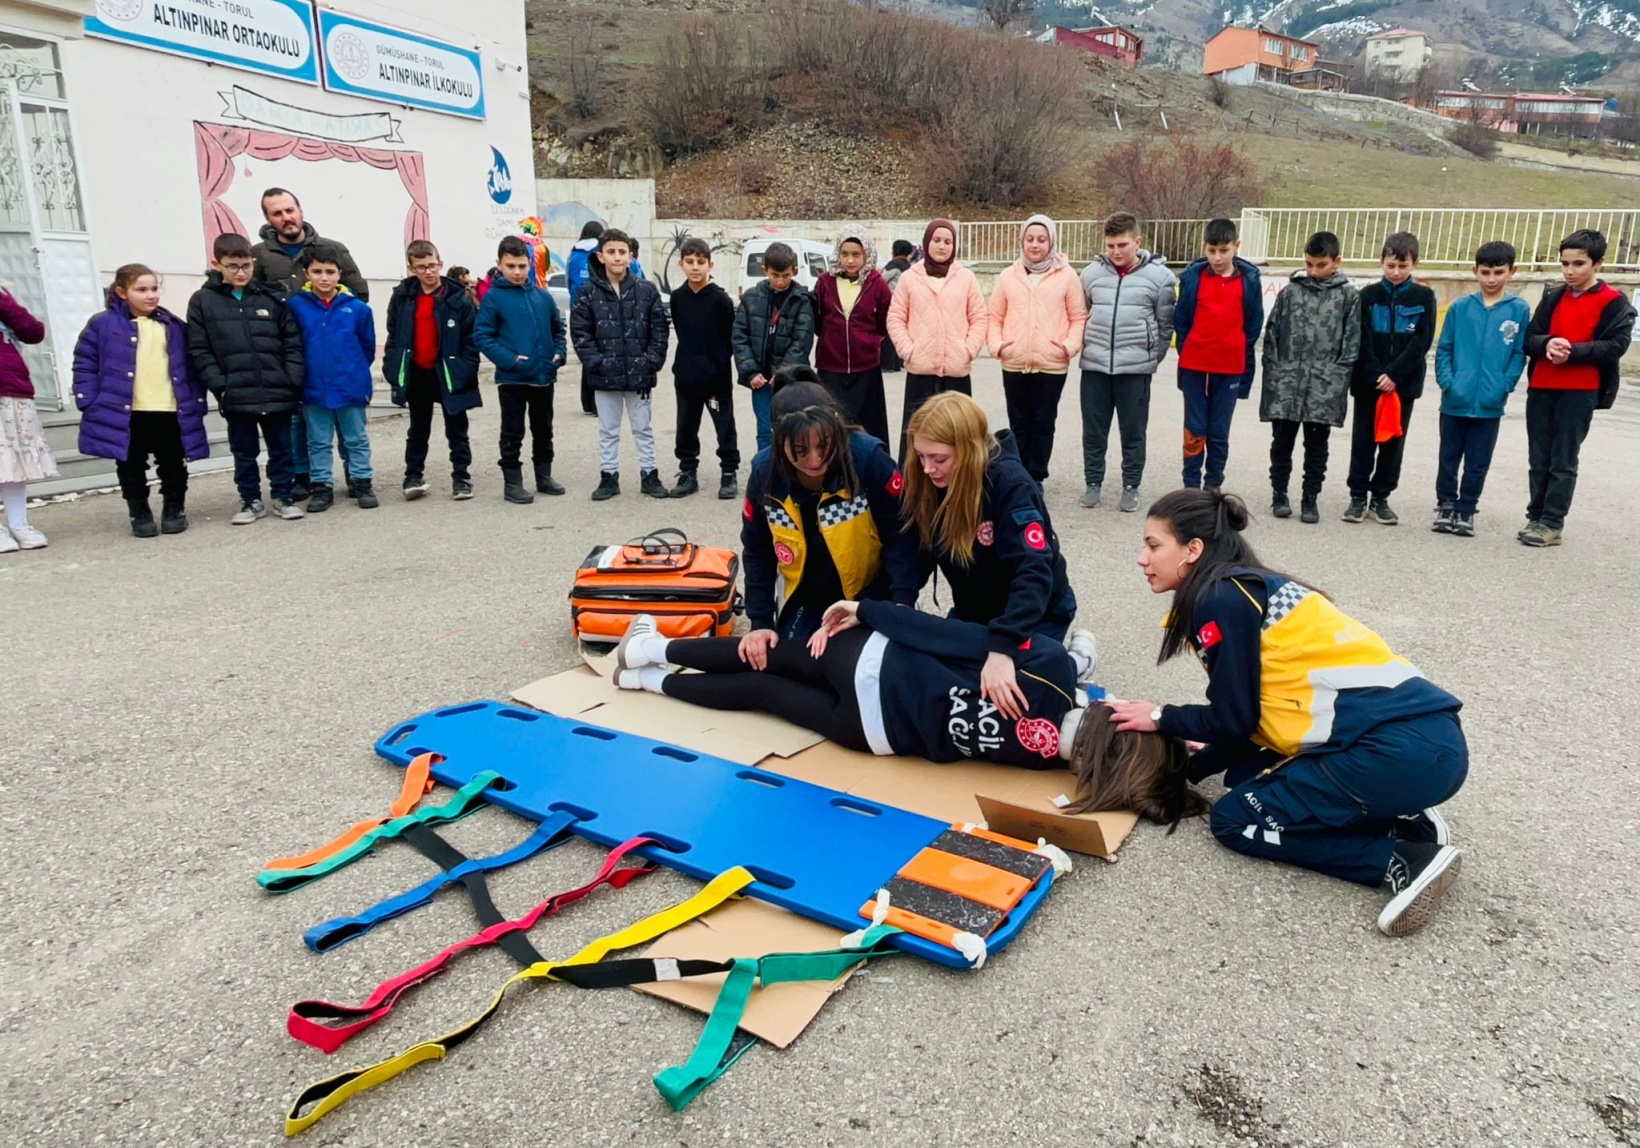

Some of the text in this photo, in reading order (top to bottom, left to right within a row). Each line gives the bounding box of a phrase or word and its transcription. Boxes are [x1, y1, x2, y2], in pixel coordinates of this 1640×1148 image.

[223, 1, 255, 19] TORUL
[153, 3, 230, 41] ALTINPINAR
[232, 23, 300, 58] ORTAOKULU
[375, 44, 419, 64] GÜMÜŞHANE
[424, 55, 445, 71] TORUL
[378, 62, 474, 98] ALTINPINAR İLKOKULU
[977, 698, 1005, 753] ACİL
